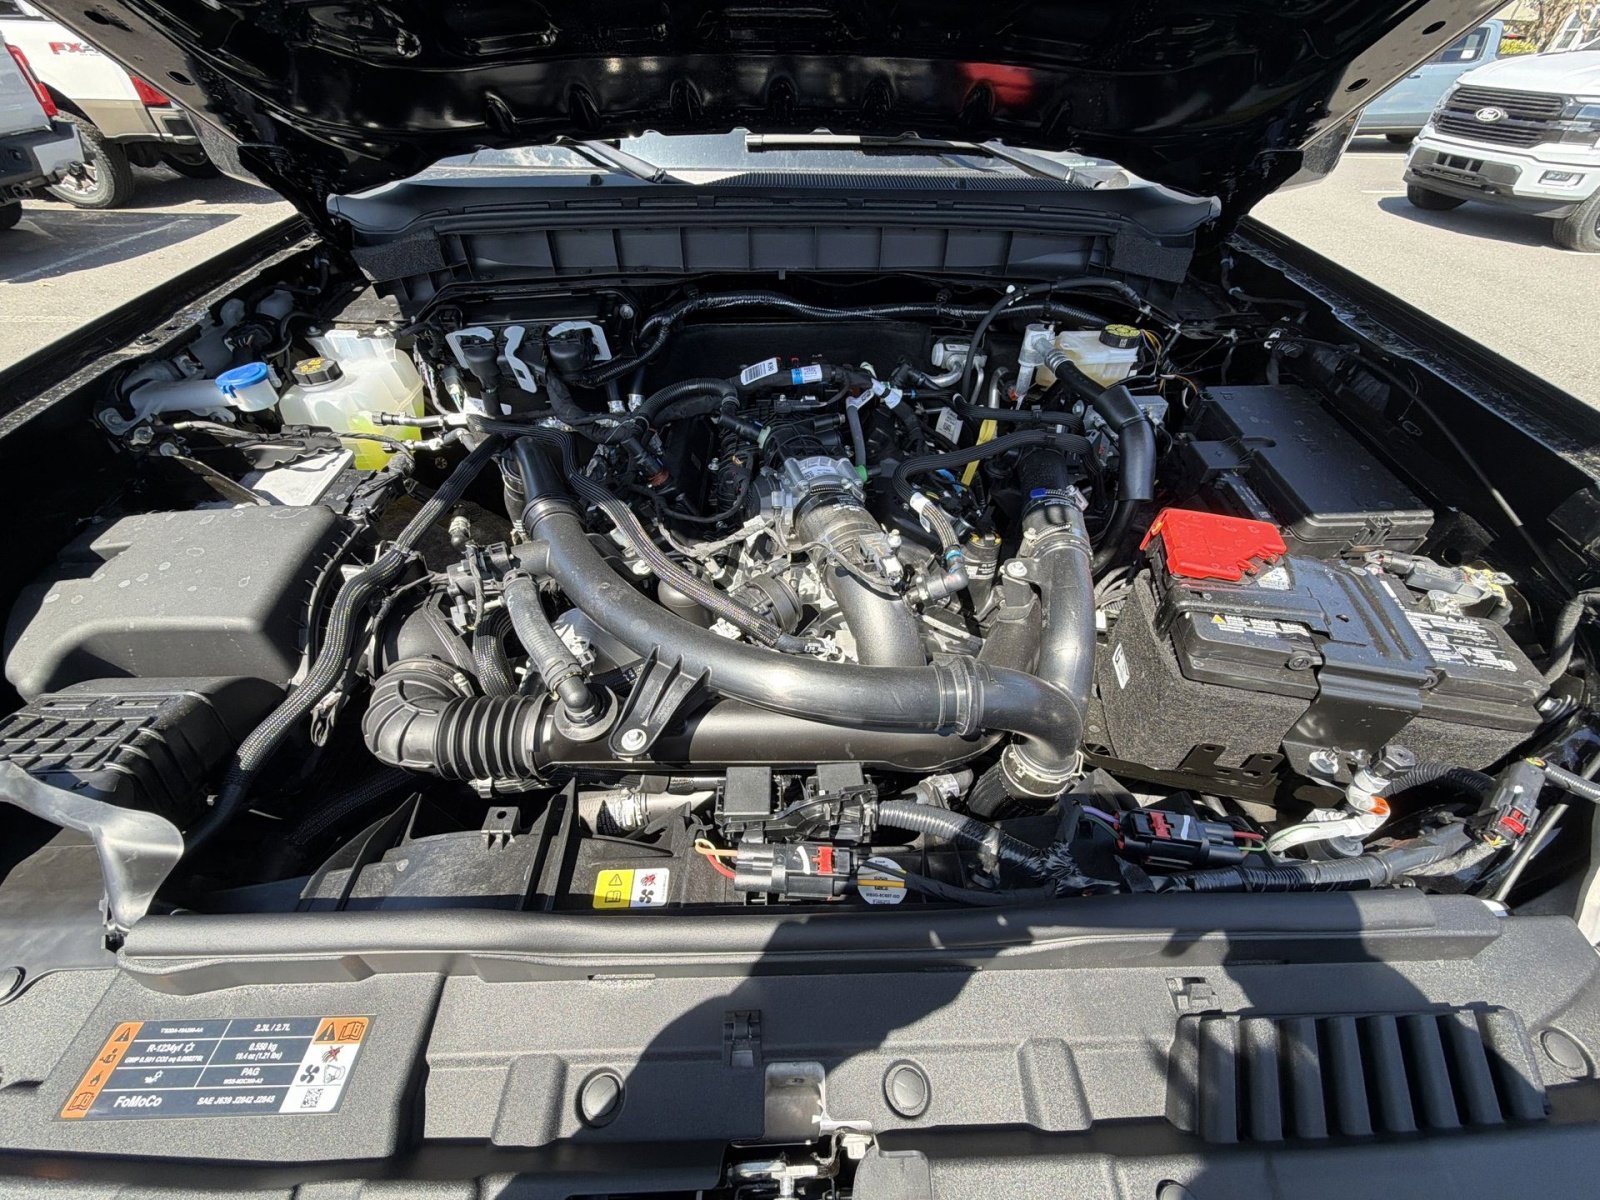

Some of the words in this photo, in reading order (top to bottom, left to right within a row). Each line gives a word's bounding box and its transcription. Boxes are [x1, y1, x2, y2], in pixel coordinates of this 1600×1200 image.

[254, 1024, 270, 1032] 2.3L
[275, 1023, 291, 1032] 2.7L
[146, 1043, 184, 1054] R-1234yf
[267, 1042, 278, 1052] kg
[240, 1067, 261, 1076] PAG
[113, 1095, 162, 1108] FoMoCo
[196, 1097, 214, 1105] SAE
